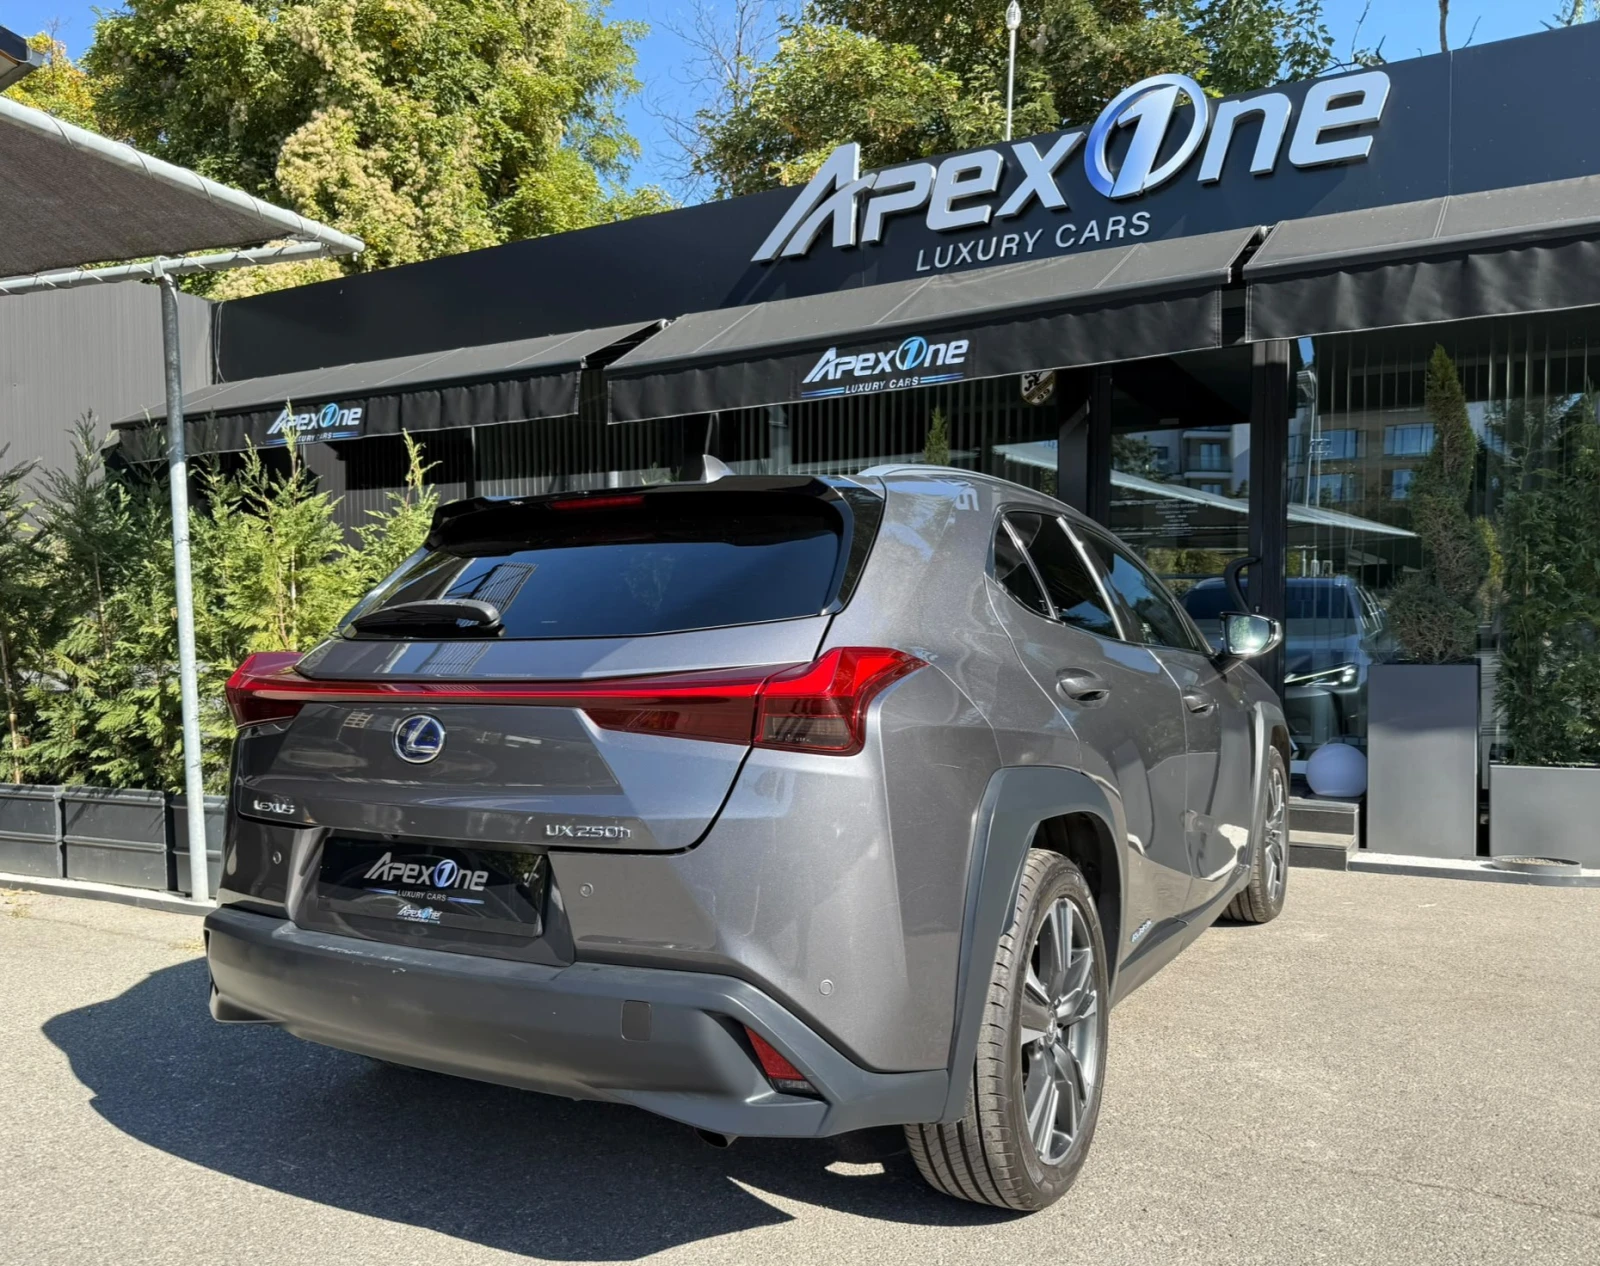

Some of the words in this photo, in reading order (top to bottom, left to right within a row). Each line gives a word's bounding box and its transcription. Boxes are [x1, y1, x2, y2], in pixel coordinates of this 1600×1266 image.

[916, 228, 1044, 272] LUXURY
[1055, 211, 1152, 249] CARS
[845, 380, 886, 394] LUXURY
[889, 376, 919, 389] CARS
[253, 800, 295, 815] LEXUS
[546, 824, 574, 837] UX
[575, 825, 631, 838] 250h
[397, 890, 426, 899] LUXURY
[426, 892, 447, 902] CARS
